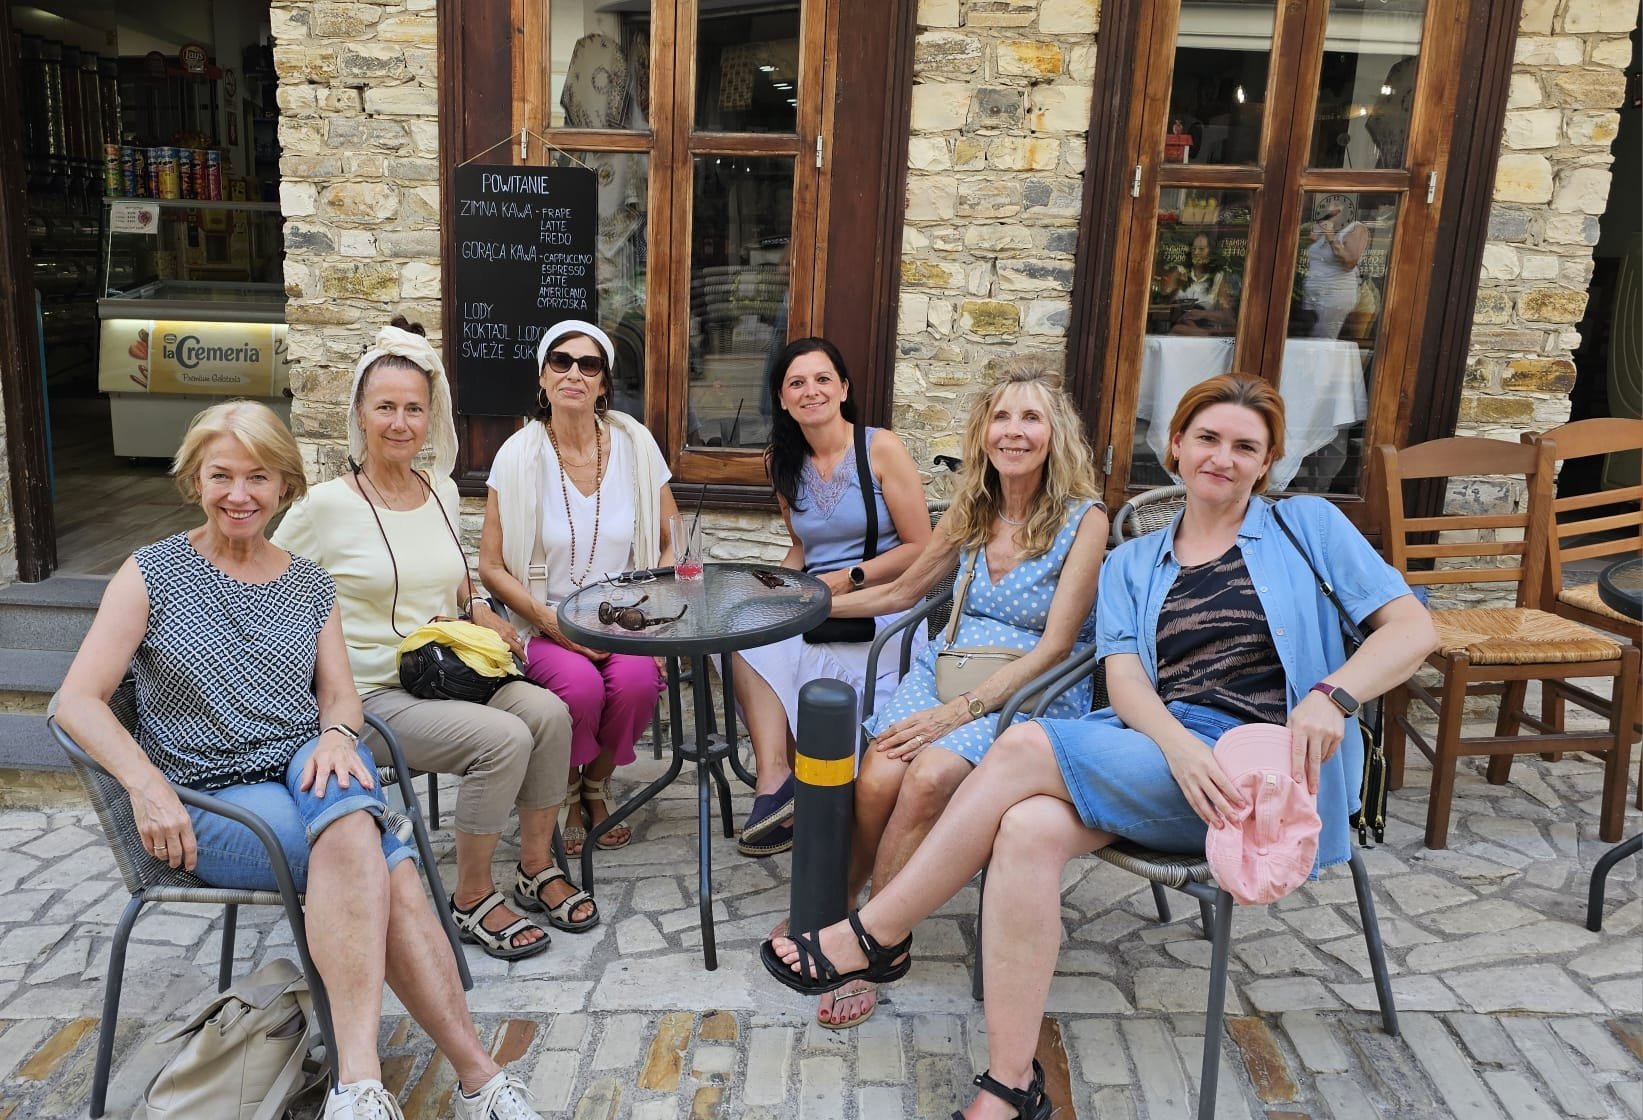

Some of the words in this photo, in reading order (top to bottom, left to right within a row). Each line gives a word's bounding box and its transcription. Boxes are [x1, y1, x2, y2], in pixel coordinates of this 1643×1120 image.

[482, 173, 549, 194] POWITANIE
[460, 200, 498, 217] ZIMNA
[502, 201, 533, 219] KAWA
[542, 208, 573, 218] FRAPE
[540, 220, 568, 231] LATTE
[540, 232, 572, 245] FREDO
[462, 241, 506, 262] GORĄCA
[510, 244, 537, 262] KAWA
[541, 264, 585, 276] ESPRESSO
[541, 275, 567, 286] LATTE
[538, 286, 587, 298] AMERICANO
[464, 302, 494, 319] LODY
[537, 297, 588, 310] CYPRYJSKA
[463, 322, 511, 339] KOKTAJL
[518, 325, 548, 342] LODO
[175, 335, 260, 369] Cremeria
[462, 340, 505, 359] ŚWIEŻE
